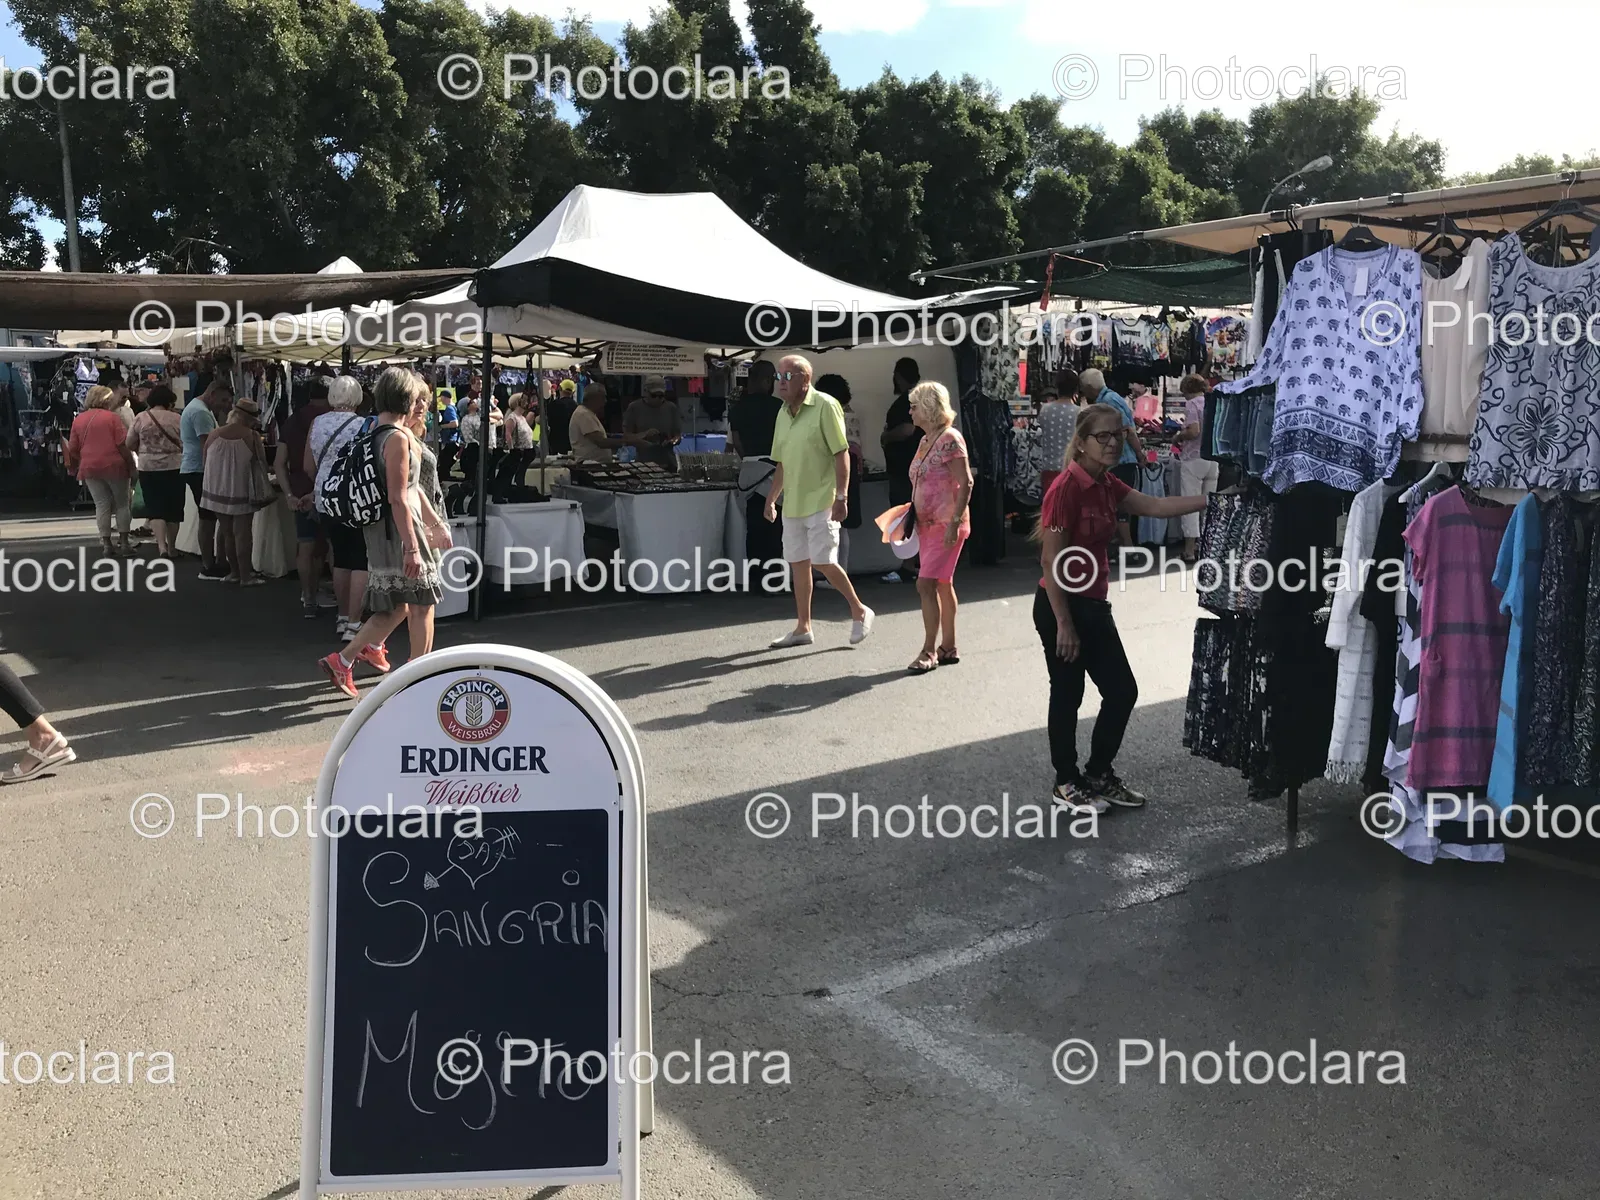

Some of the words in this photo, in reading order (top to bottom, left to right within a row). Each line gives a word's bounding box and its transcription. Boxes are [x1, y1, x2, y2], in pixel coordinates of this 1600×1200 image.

[442, 681, 505, 707] ERDINGER
[400, 745, 551, 777] ERDINGER
[424, 778, 522, 807] Weißbier
[362, 850, 608, 968] SANGRIA
